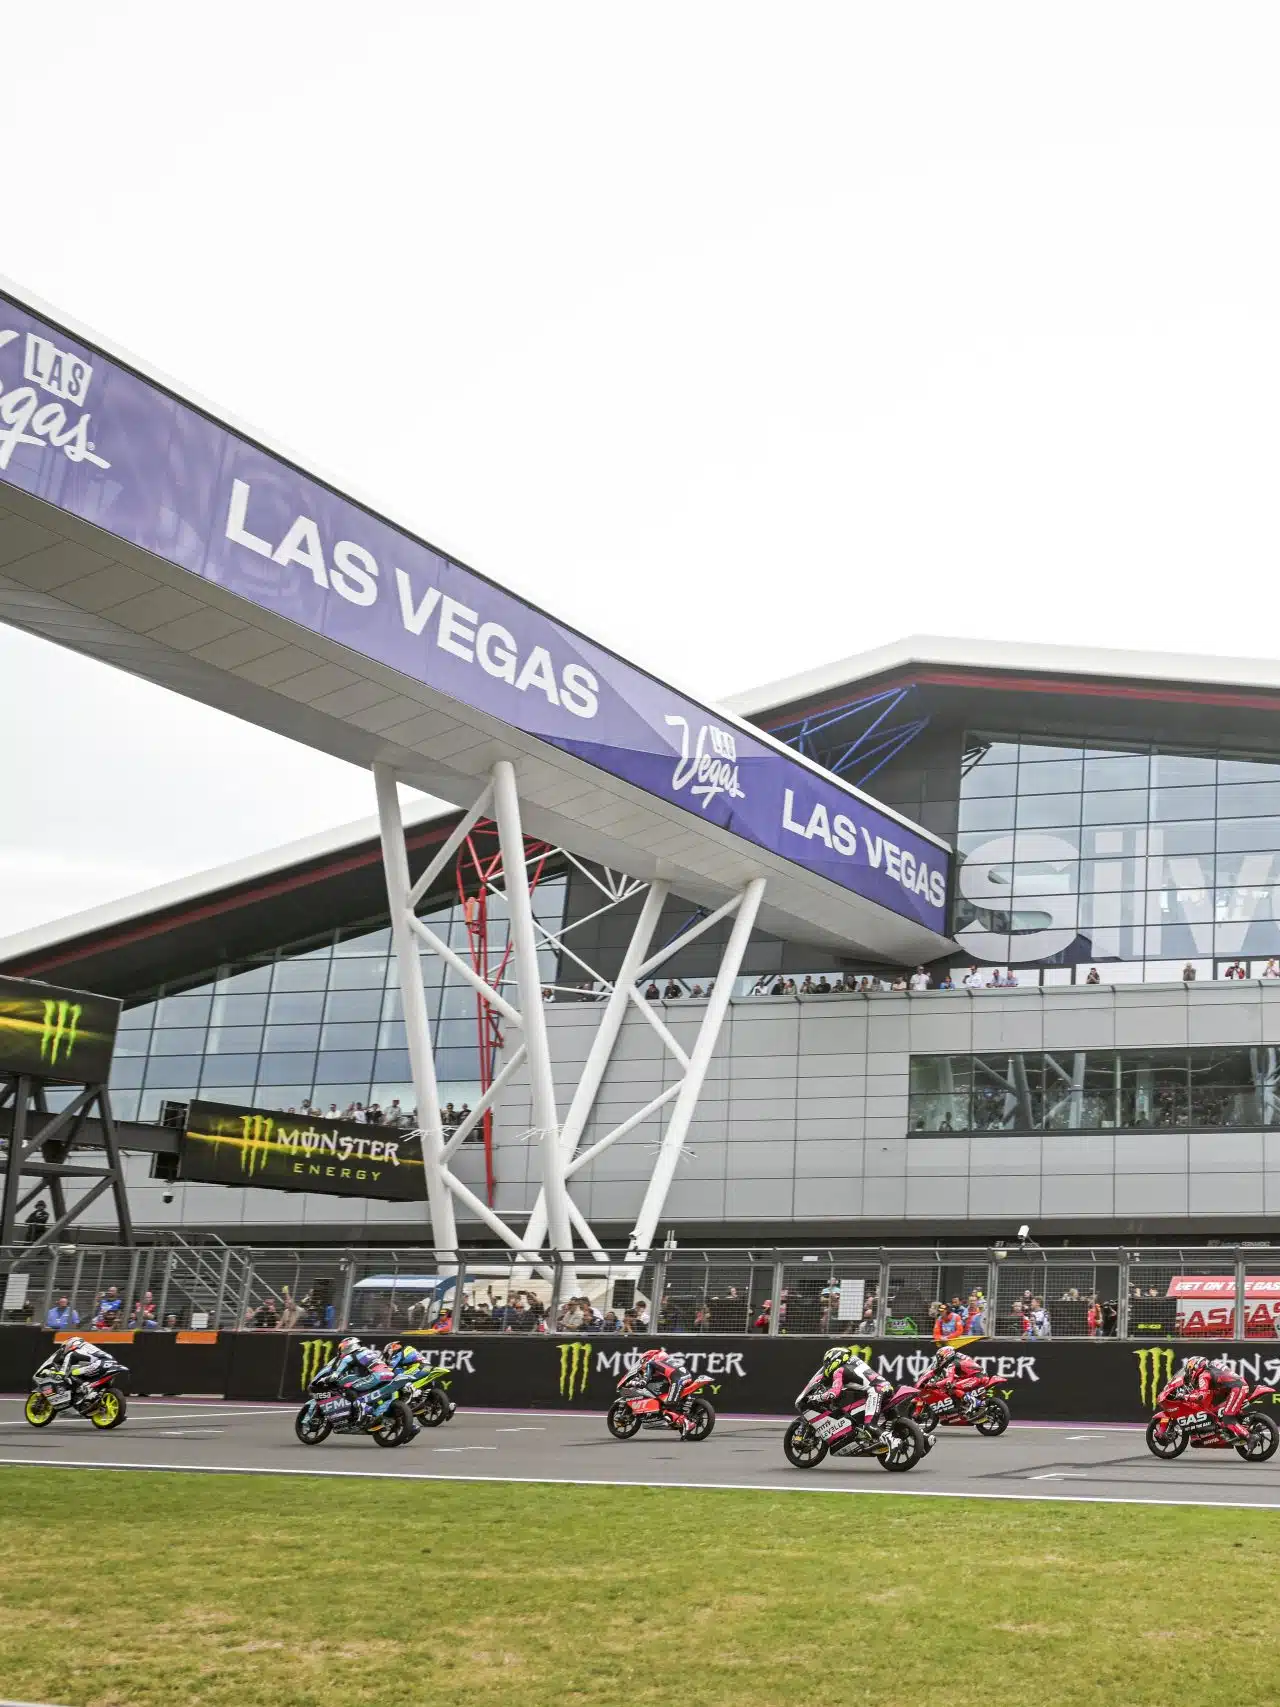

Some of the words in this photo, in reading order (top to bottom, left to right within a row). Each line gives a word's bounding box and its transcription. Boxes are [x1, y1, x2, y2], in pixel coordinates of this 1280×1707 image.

[32, 342, 84, 396] LAS
[225, 479, 379, 607] LAS
[395, 567, 601, 719] VEGAS
[664, 715, 746, 809] Vegas
[782, 788, 857, 856] LAS
[860, 826, 947, 908] VEGAS
[277, 1126, 400, 1167] MONSTER
[293, 1162, 381, 1181] ENERGY
[1175, 1281, 1204, 1291] GET
[1203, 1281, 1226, 1291] ON
[1227, 1281, 1253, 1291] TE
[1176, 1410, 1207, 1427] GAS
